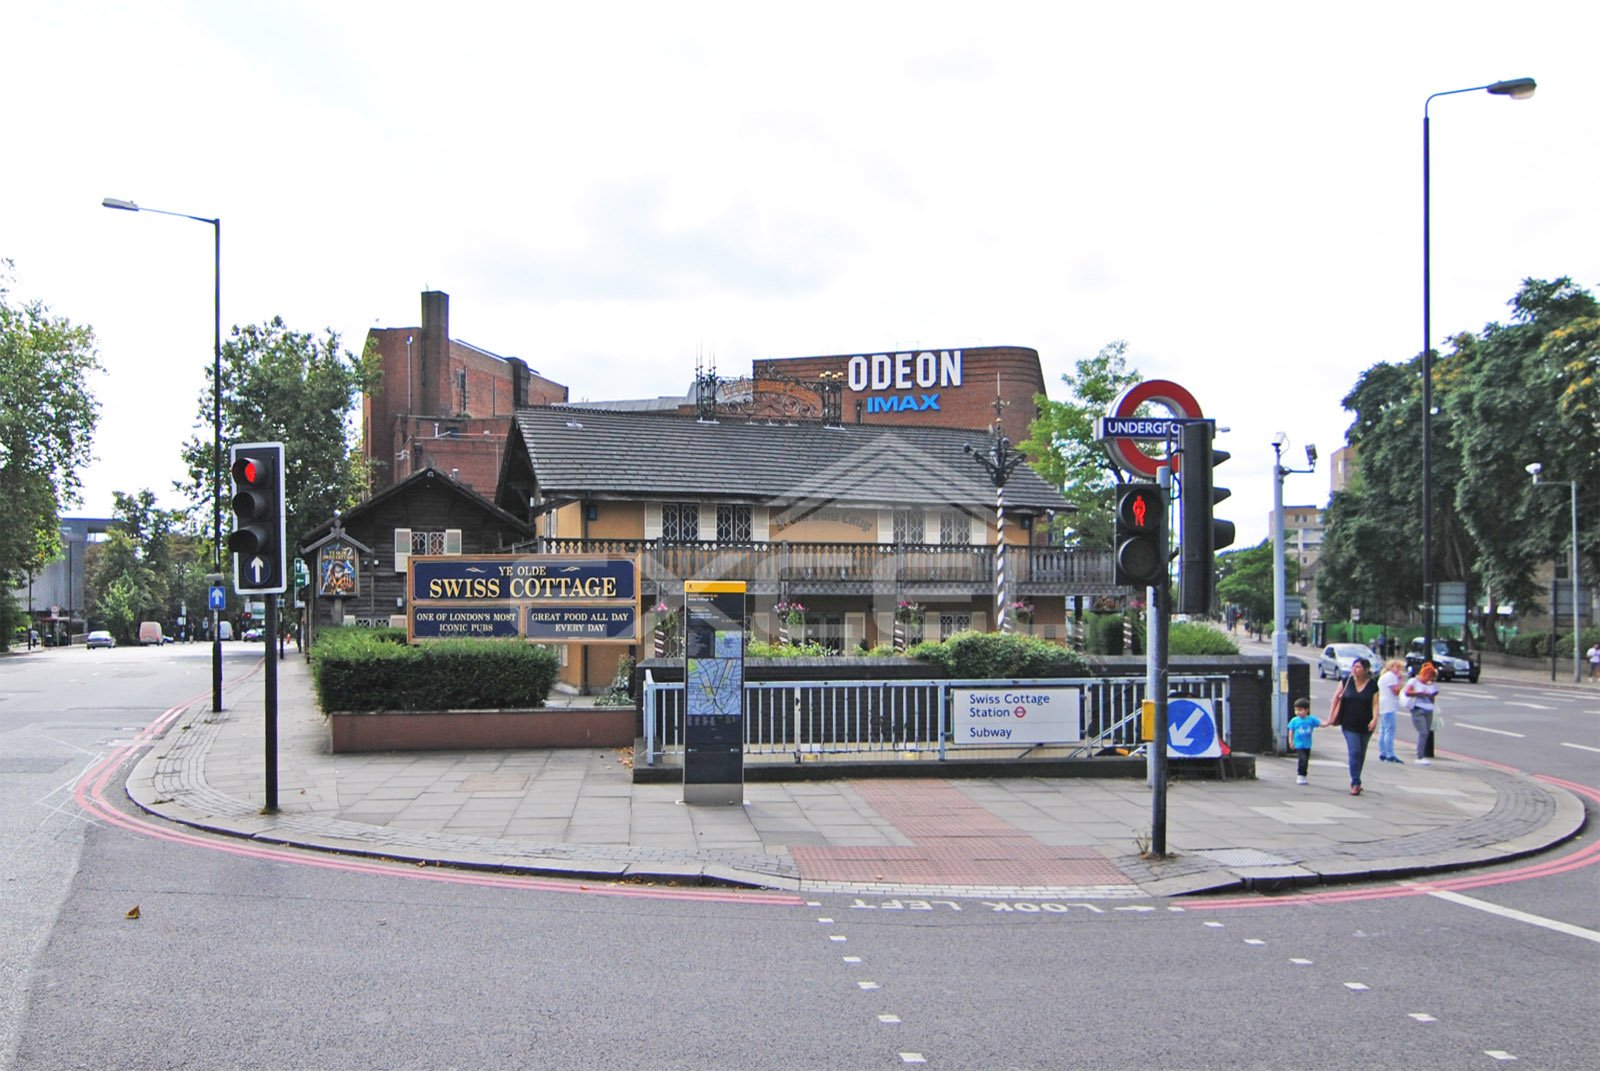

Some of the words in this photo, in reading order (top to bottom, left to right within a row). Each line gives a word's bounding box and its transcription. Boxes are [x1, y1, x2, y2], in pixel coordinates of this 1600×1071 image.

[848, 350, 963, 392] ODEON
[867, 393, 941, 413] IMAX
[1108, 421, 1179, 434] UNDERGO
[498, 566, 513, 576] YE
[517, 566, 547, 576] OLDE
[429, 578, 501, 598] SWISS
[510, 577, 617, 598] COTTAGE
[416, 613, 434, 621] ONE
[436, 613, 447, 621] OF
[449, 613, 491, 621] LONDON'S
[493, 613, 516, 621] MOST
[531, 613, 561, 621] GREAT
[564, 613, 588, 621] FOOD
[590, 613, 608, 621] ALL
[611, 613, 629, 621] DAY
[555, 624, 585, 632] EVERY
[587, 624, 604, 632] DAY
[969, 694, 1000, 704] Swiss
[1004, 693, 1050, 706] Cottage
[969, 707, 1010, 717] Station
[969, 727, 1012, 740] Subway
[850, 899, 962, 911] LEFT
[981, 901, 1105, 913] LOOK
